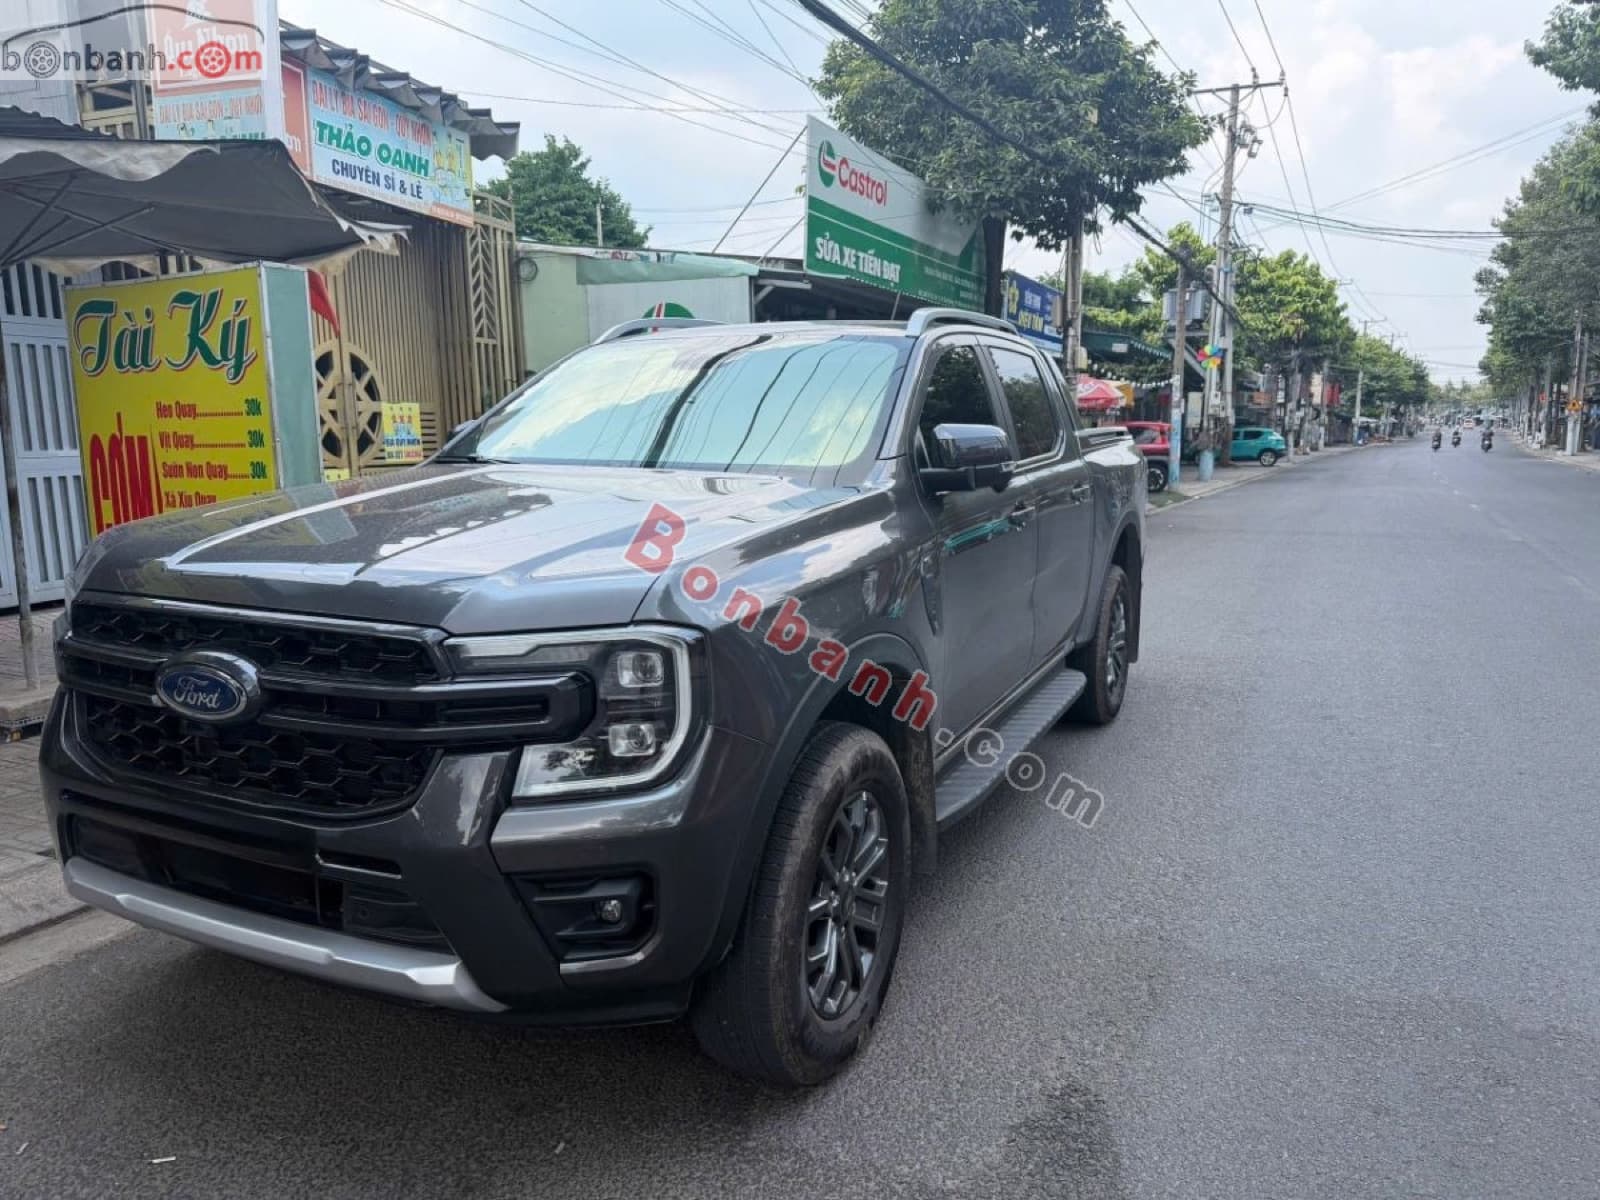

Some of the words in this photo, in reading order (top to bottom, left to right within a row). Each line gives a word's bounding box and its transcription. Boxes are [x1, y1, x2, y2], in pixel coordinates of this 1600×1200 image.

[315, 119, 372, 158] THẢO
[376, 143, 430, 178] OANH
[332, 158, 380, 187] CHUYÊN
[399, 179, 408, 194] &
[837, 156, 888, 206] Castrol
[815, 232, 842, 266] SỬA
[842, 246, 857, 269] XE
[73, 298, 161, 378] Tài
[165, 288, 258, 384] Ký
[156, 401, 173, 419] Heo
[175, 401, 198, 421] Quay
[245, 398, 262, 417] 30k
[159, 432, 173, 453] Vịt
[173, 432, 195, 450] Quay
[248, 430, 265, 449] 30k
[206, 462, 229, 481] Quay
[250, 461, 268, 480] 30k
[174, 676, 220, 709] Ford
